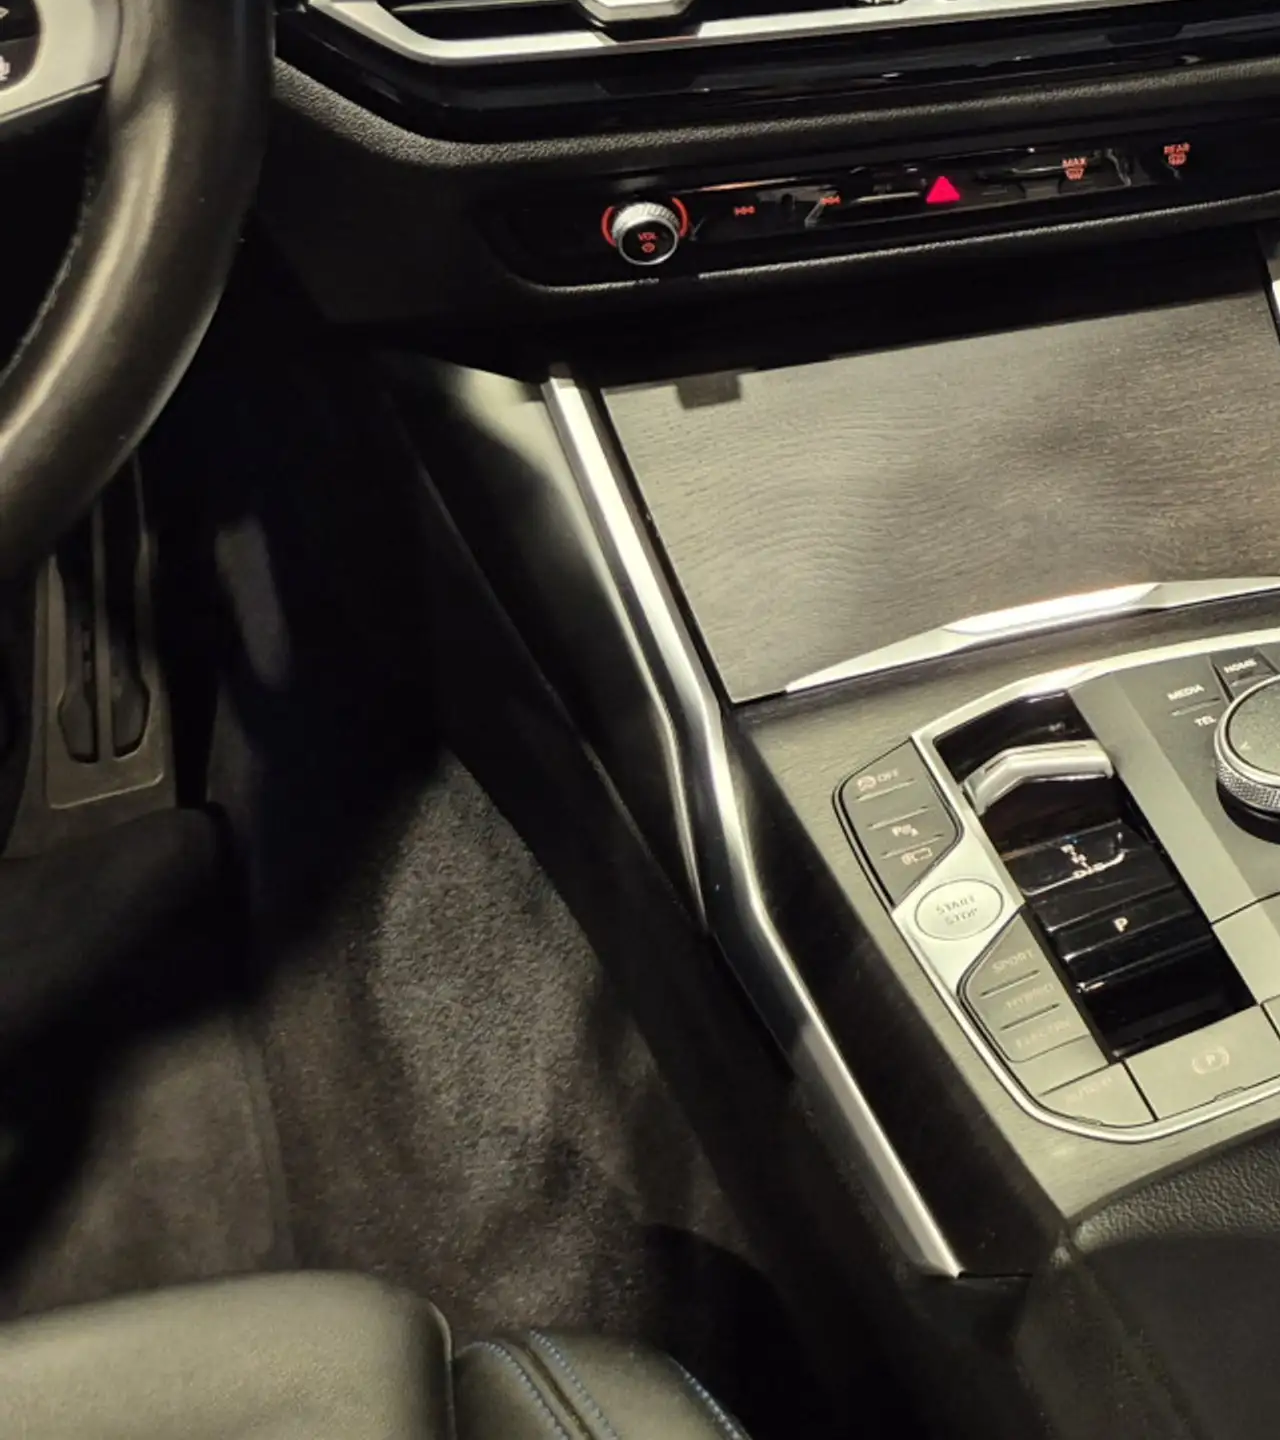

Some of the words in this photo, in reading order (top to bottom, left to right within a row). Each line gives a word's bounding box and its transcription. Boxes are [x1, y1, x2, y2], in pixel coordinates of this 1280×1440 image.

[1223, 658, 1258, 673] HOME
[1167, 684, 1205, 701] MEDIA
[1194, 715, 1217, 727] TEL
[936, 895, 976, 915] START
[944, 908, 978, 926] STOP
[1113, 917, 1128, 933] P
[992, 947, 1034, 973] SPORT
